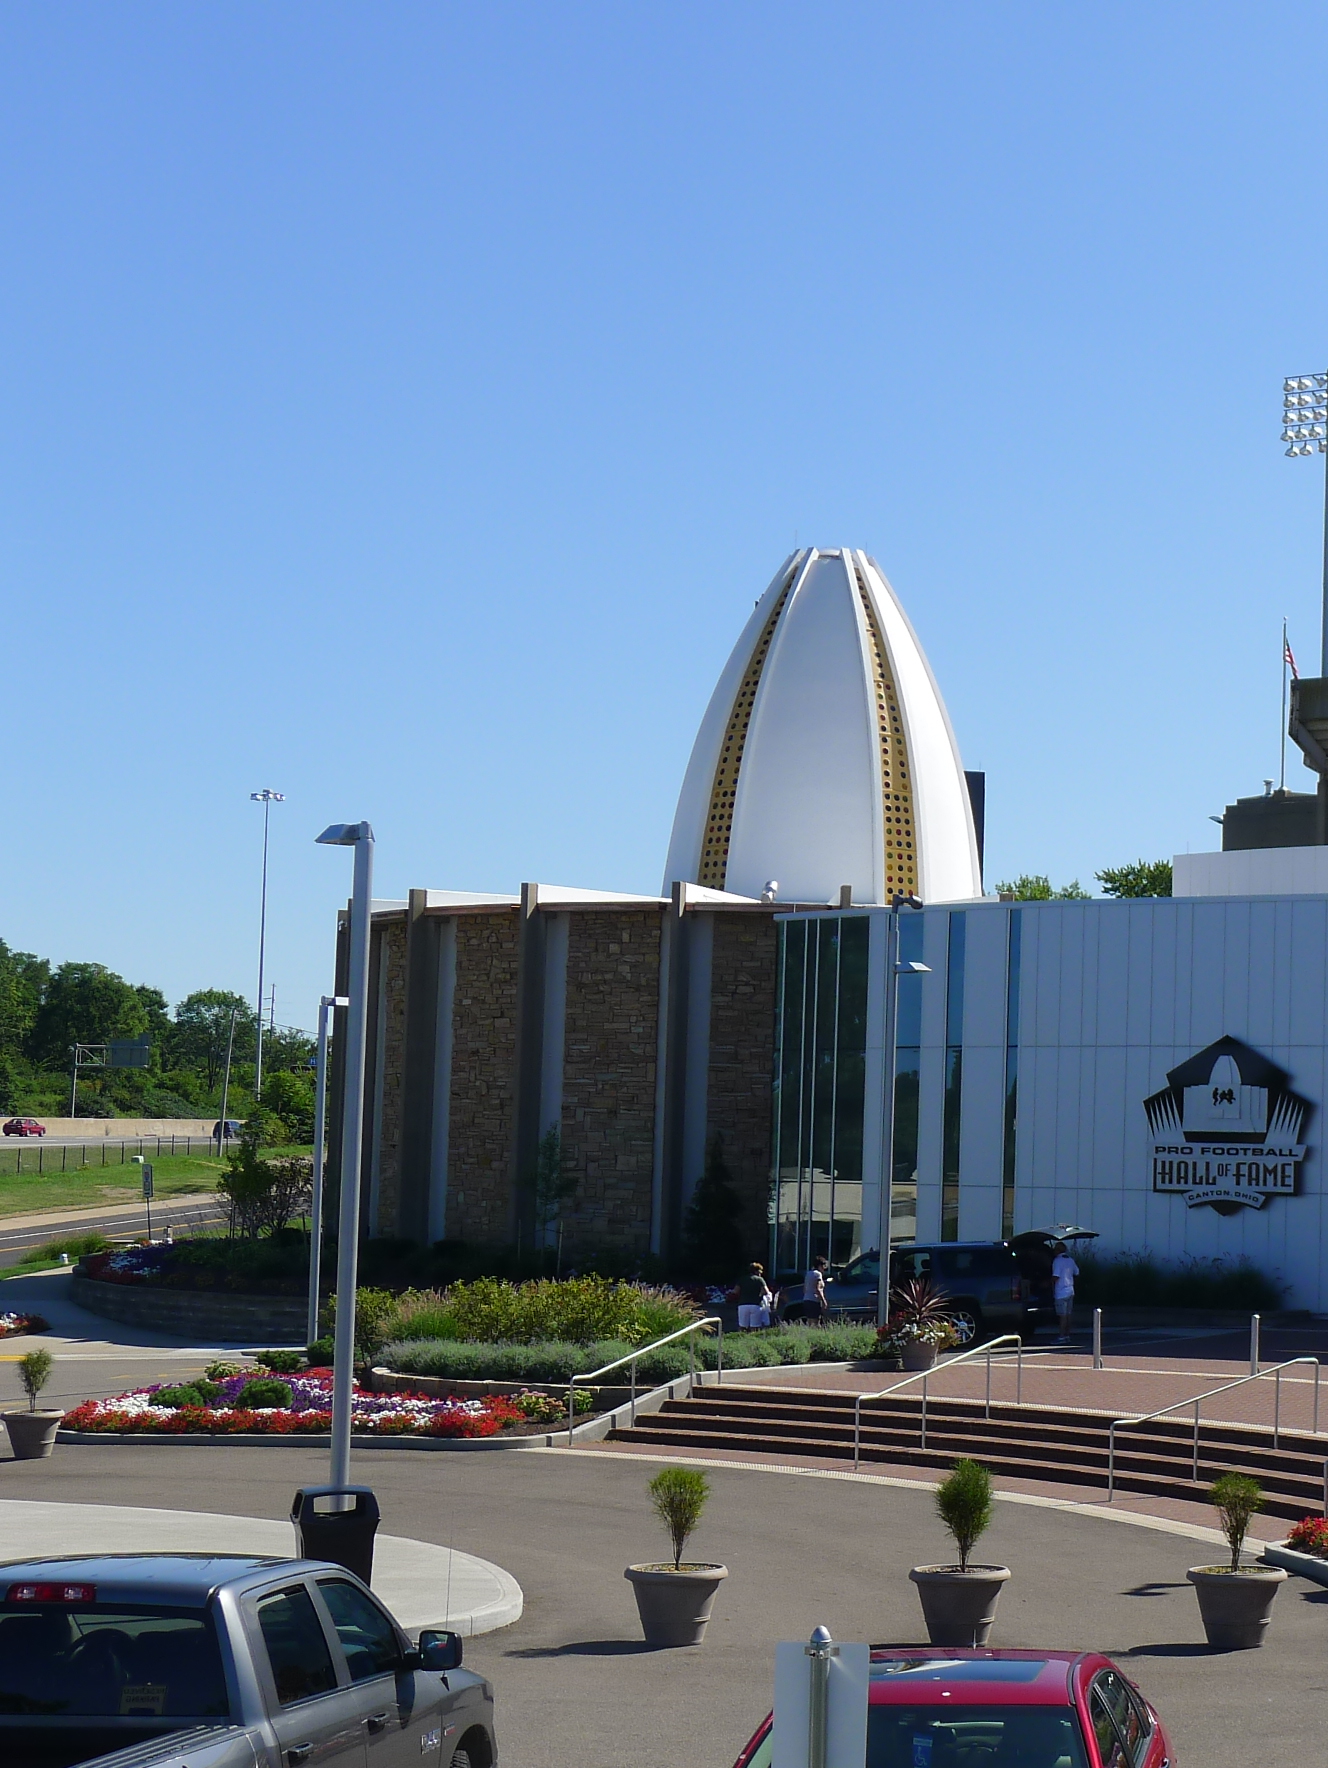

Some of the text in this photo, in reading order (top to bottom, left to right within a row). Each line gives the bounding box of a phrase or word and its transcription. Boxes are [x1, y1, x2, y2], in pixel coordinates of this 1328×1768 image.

[1154, 1145, 1299, 1157] PRO FOOTBALL
[1158, 1160, 1293, 1187] HALL OF FAME
[1234, 1191, 1259, 1203] OHIO
